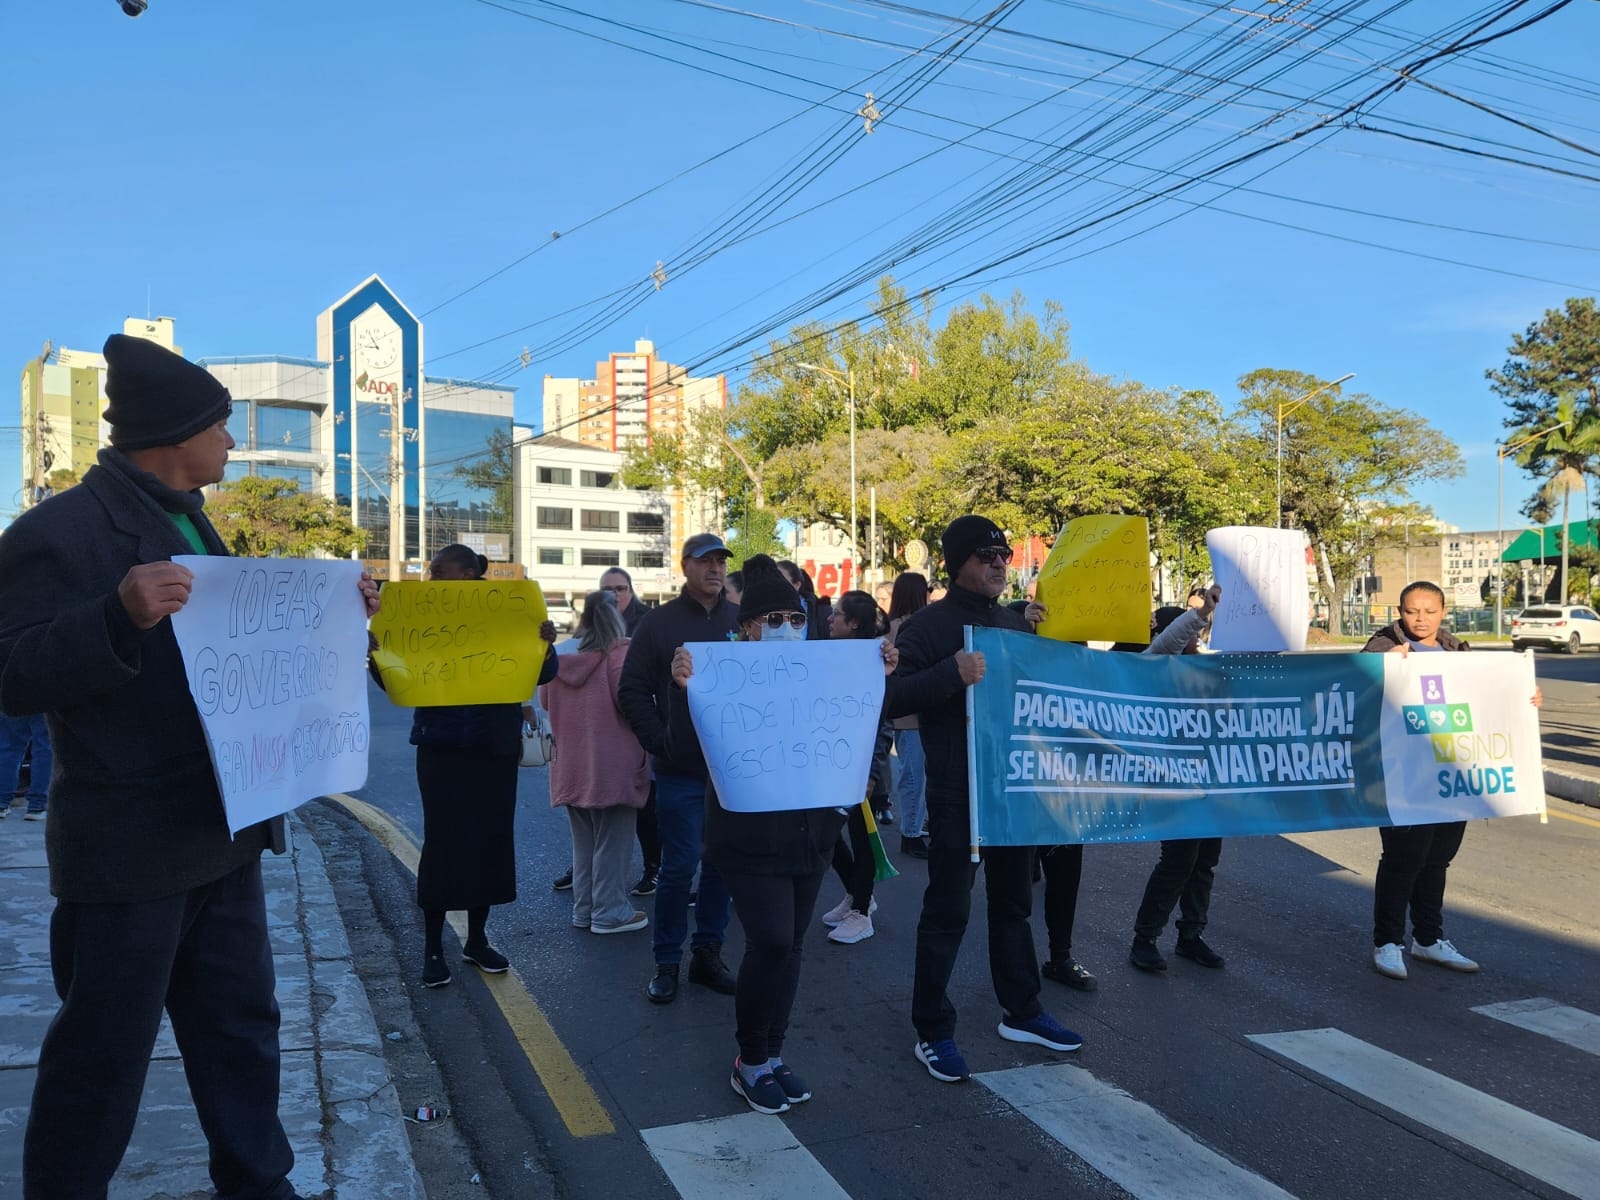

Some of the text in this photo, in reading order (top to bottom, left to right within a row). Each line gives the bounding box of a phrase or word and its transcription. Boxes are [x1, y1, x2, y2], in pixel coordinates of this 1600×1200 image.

[228, 568, 327, 639] IDEAS
[379, 586, 528, 623] QUEREMOS
[193, 645, 340, 717] GOVERNO
[790, 692, 879, 725] NOSSA
[1013, 682, 1355, 739] PAGUEM O NOSSO PISO SALARIAL JÁ!
[1006, 740, 1355, 785] SE NÃO, A ENFERMAGEM VAI PARAR!
[1456, 733, 1514, 763] SINDI
[1437, 763, 1517, 799] SAÚDE
